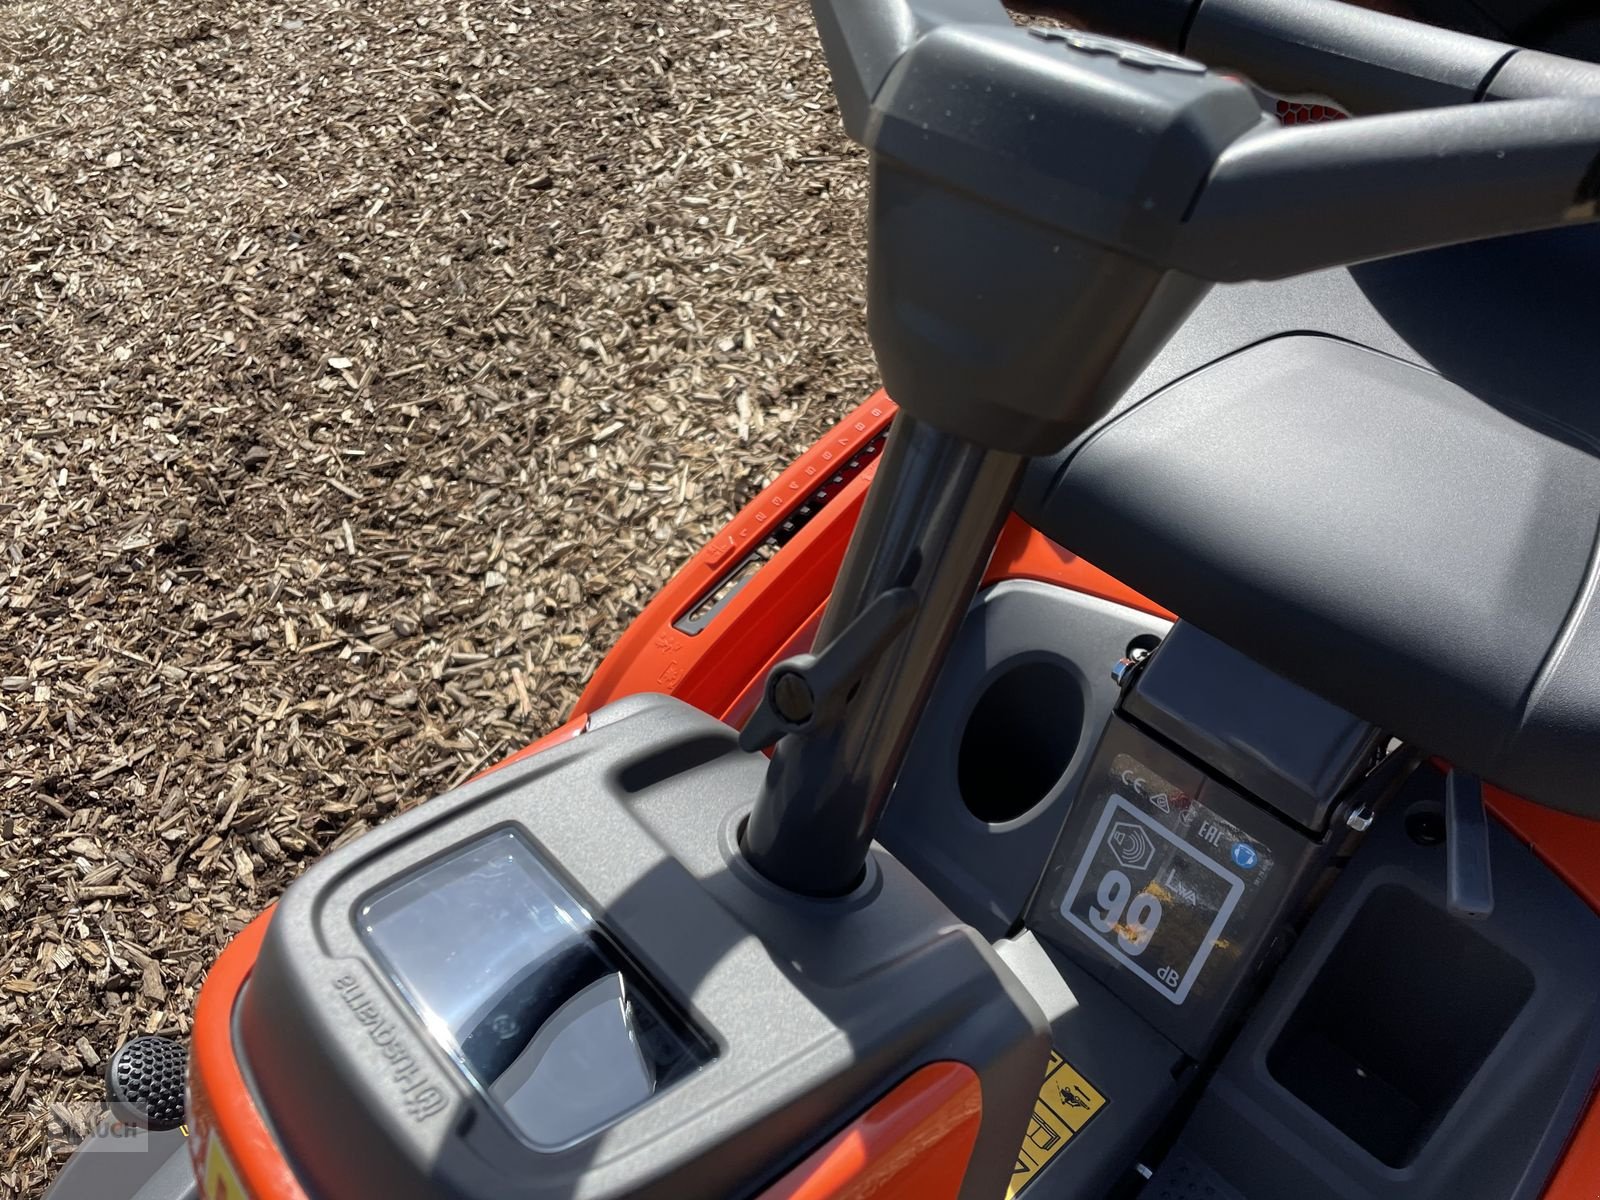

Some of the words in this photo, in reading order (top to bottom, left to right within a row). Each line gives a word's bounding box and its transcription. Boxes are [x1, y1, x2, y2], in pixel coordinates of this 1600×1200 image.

[854, 421, 866, 431] 8
[1121, 769, 1147, 795] CE
[1088, 869, 1164, 957] 99
[1156, 965, 1181, 989] dB
[332, 974, 429, 1095] Husqvarna
